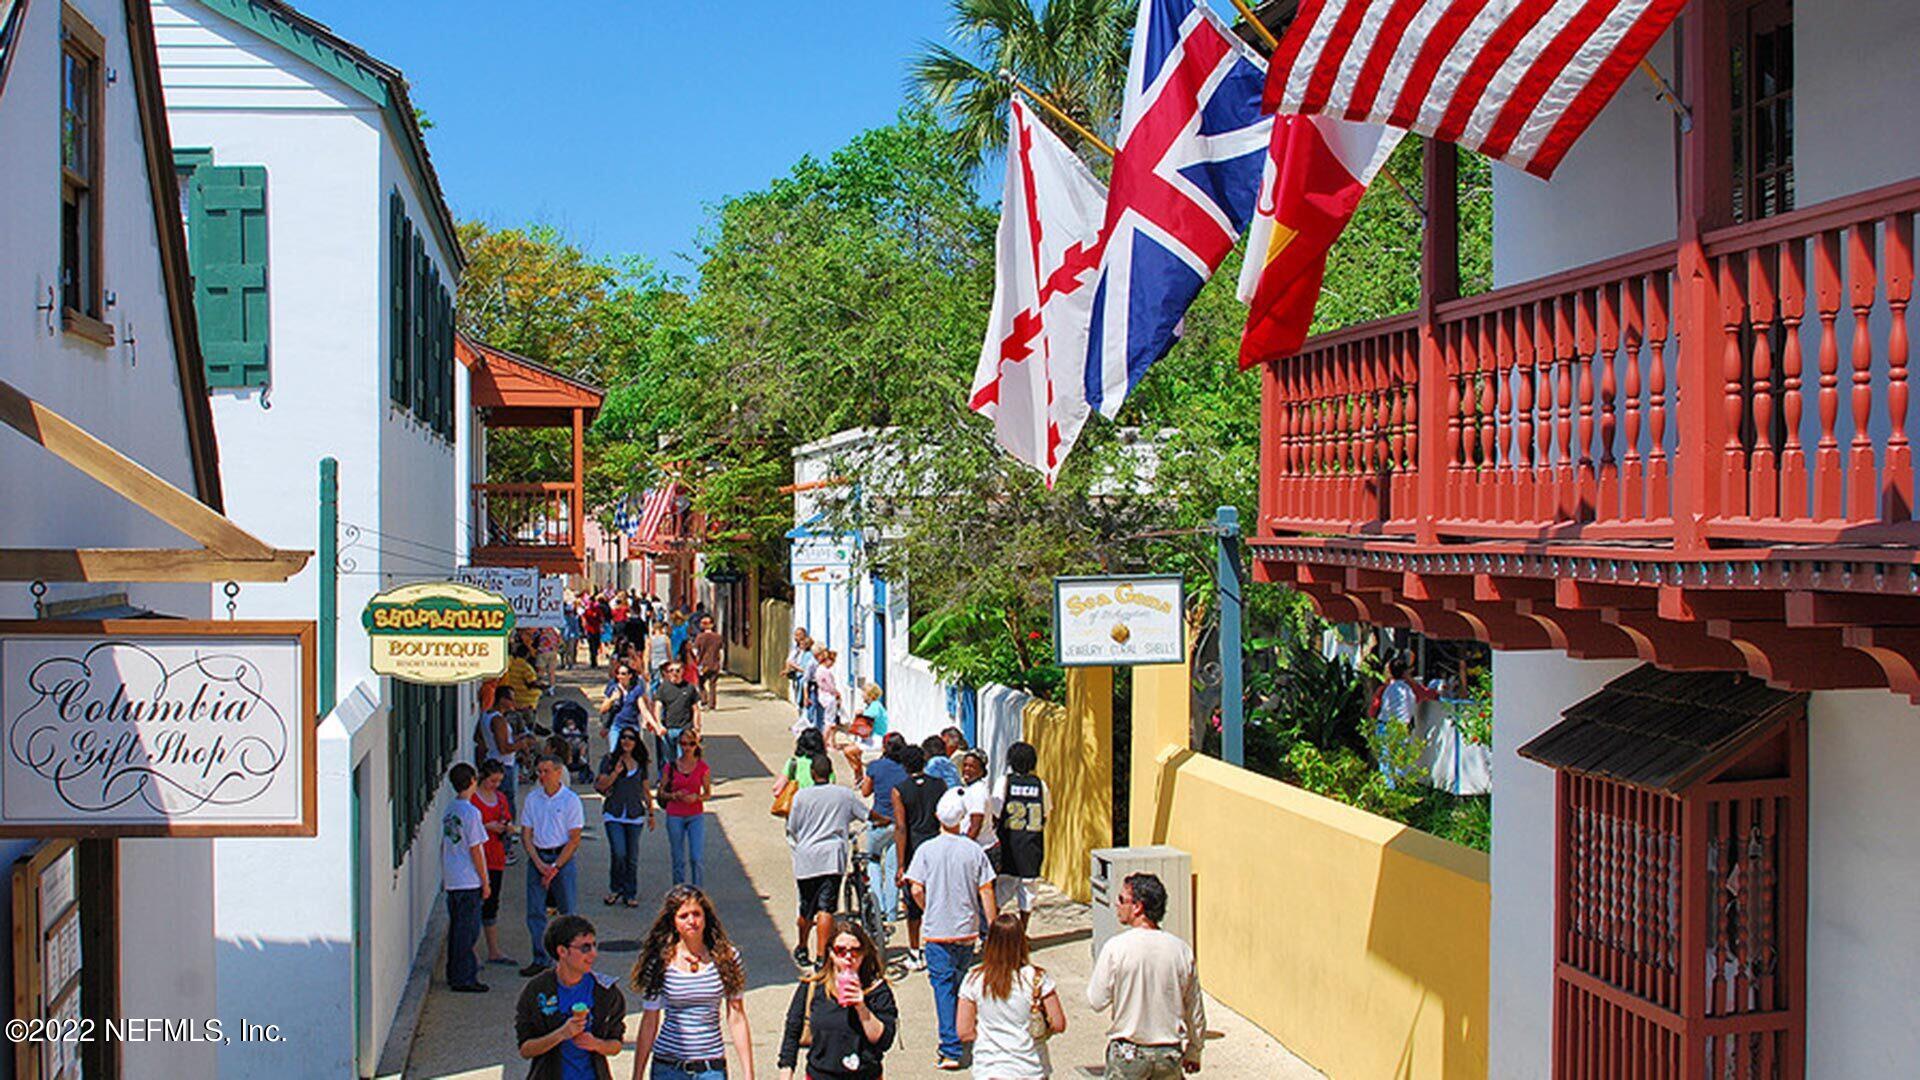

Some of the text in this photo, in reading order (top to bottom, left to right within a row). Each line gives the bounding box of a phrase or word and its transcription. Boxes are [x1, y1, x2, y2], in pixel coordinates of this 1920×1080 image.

[373, 607, 505, 630] SHOPAHOLIC
[1066, 595, 1112, 617] Sea
[388, 640, 490, 658] BOUTIQUE
[53, 679, 251, 724] Columbia
[70, 729, 227, 780] Gift Shop
[1005, 800, 1042, 832] 21
